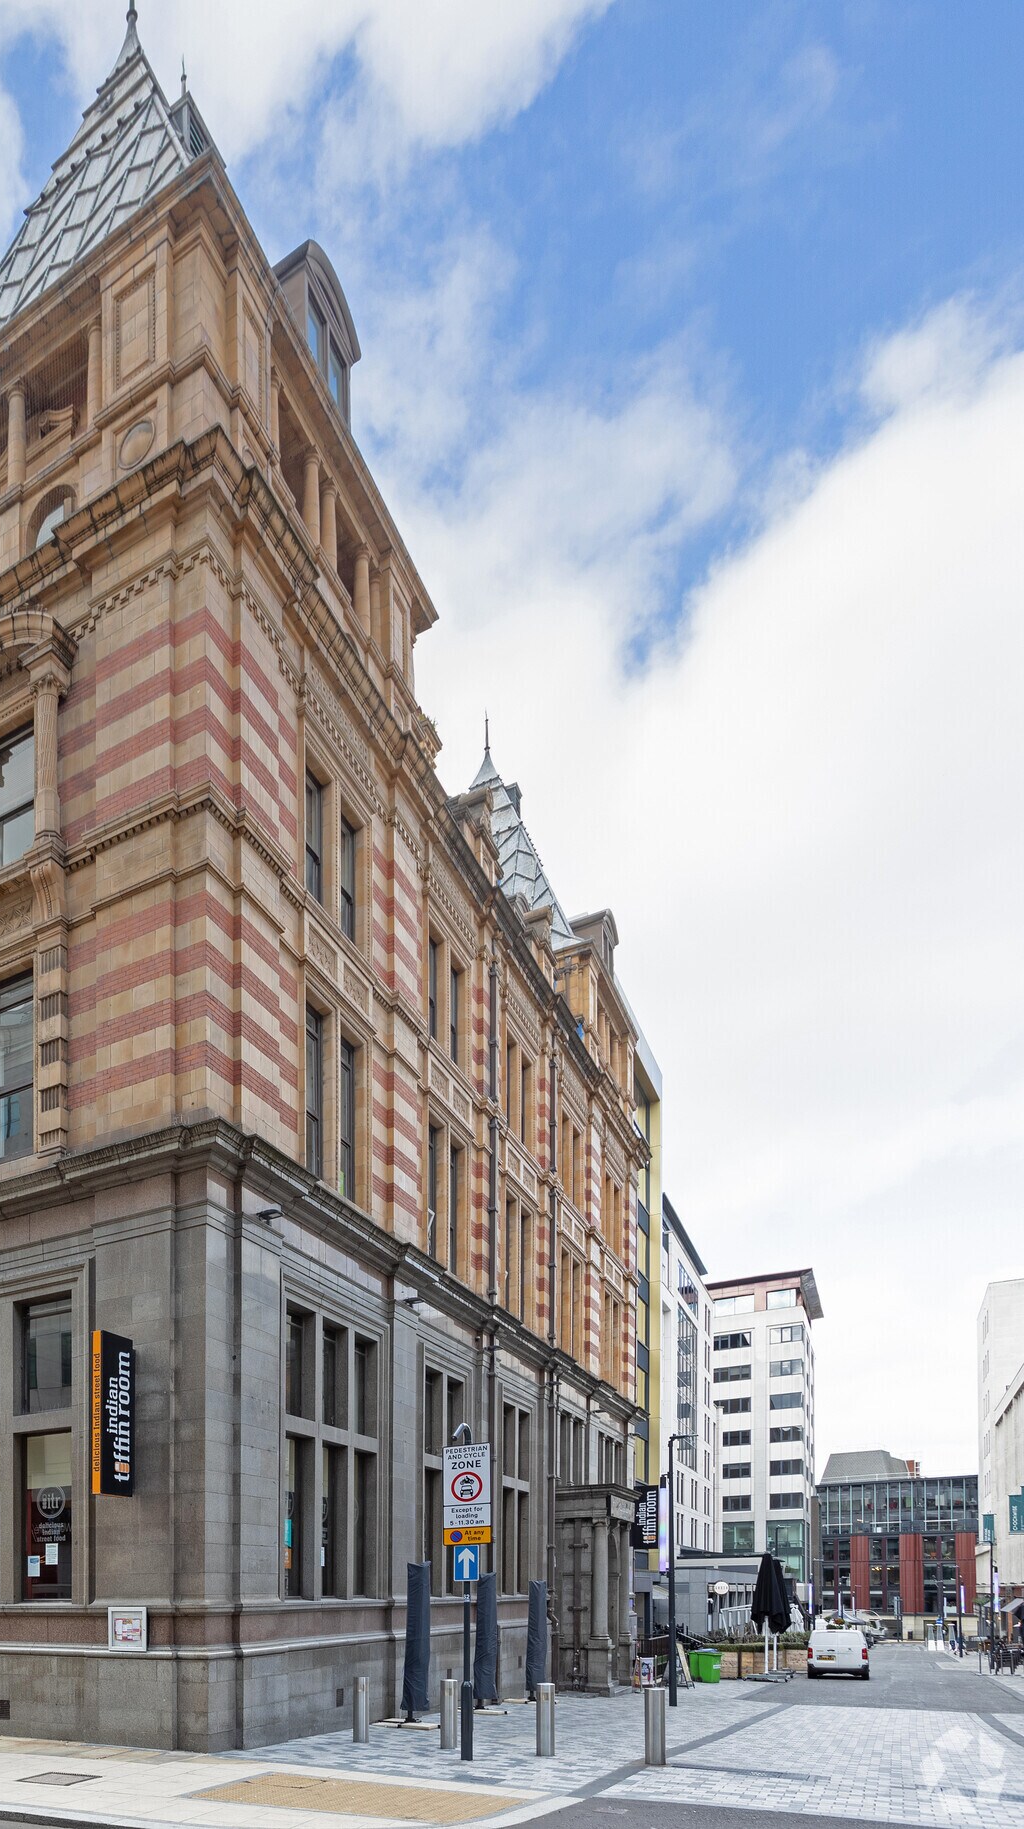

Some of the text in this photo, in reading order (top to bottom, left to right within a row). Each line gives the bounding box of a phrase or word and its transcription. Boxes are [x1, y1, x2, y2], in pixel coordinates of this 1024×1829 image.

[119, 1352, 130, 1417] room
[106, 1377, 118, 1434] indian
[446, 1446, 488, 1454] PEDESTRIAN
[451, 1460, 482, 1469] ZONE
[48, 1494, 60, 1509] itr
[647, 1490, 656, 1517] room
[636, 1502, 646, 1526] indian
